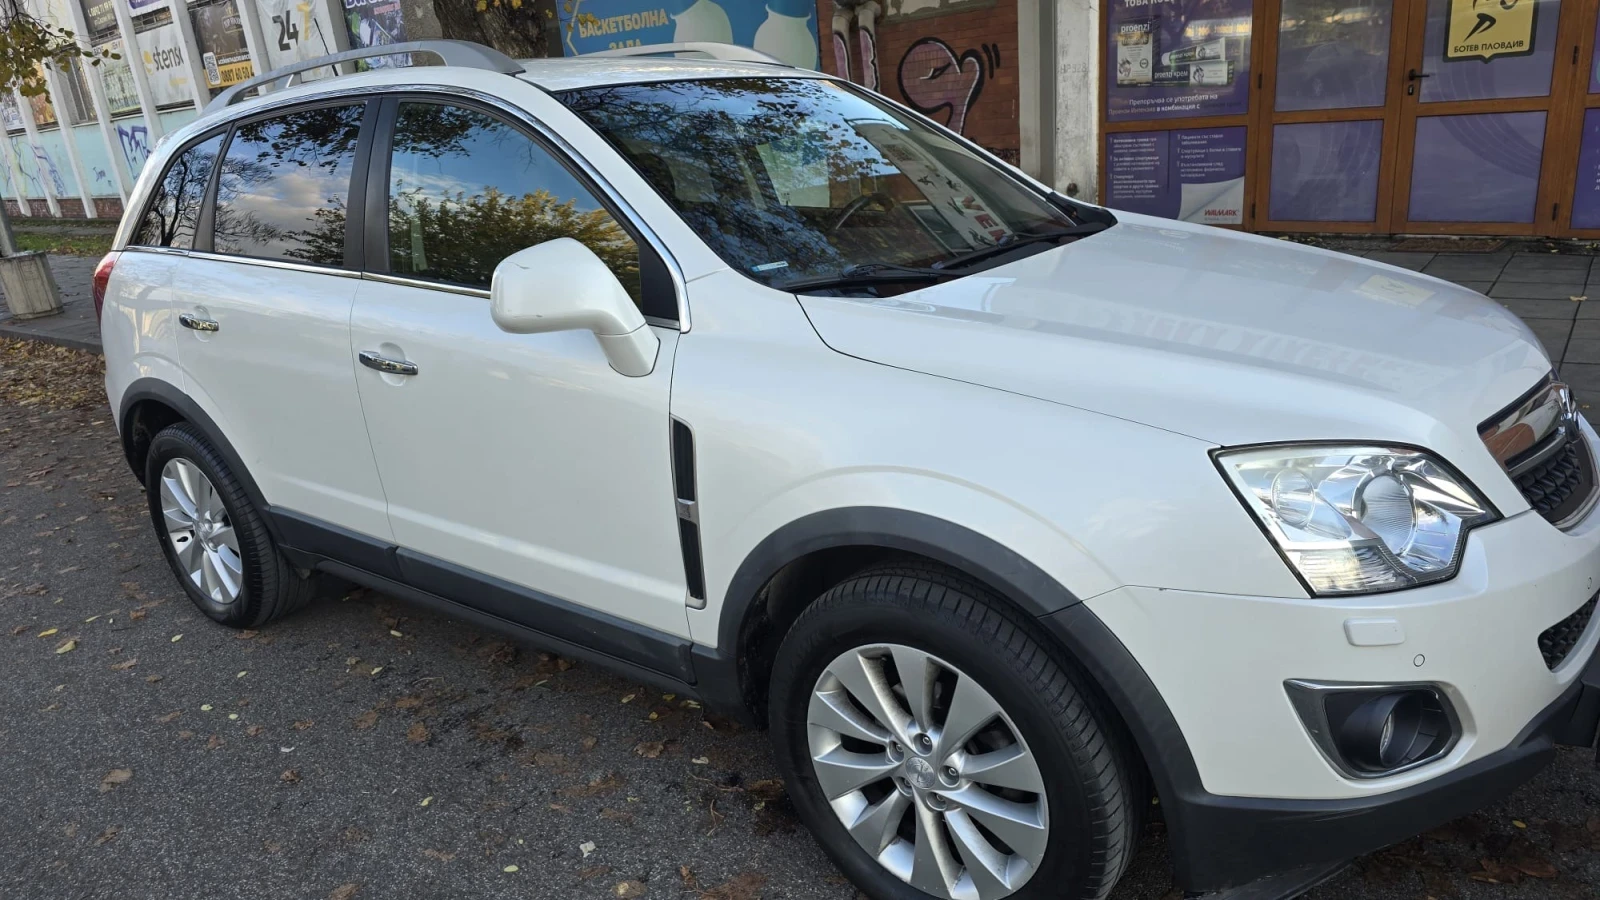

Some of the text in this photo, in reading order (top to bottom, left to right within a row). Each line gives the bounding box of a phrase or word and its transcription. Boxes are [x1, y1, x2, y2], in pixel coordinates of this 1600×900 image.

[272, 10, 299, 51] 24
[578, 8, 669, 38] БАСКЕТБОЛНА
[1121, 22, 1150, 33] proenzi
[1454, 40, 1524, 53] БОТЕВ ПЛОВДИВ
